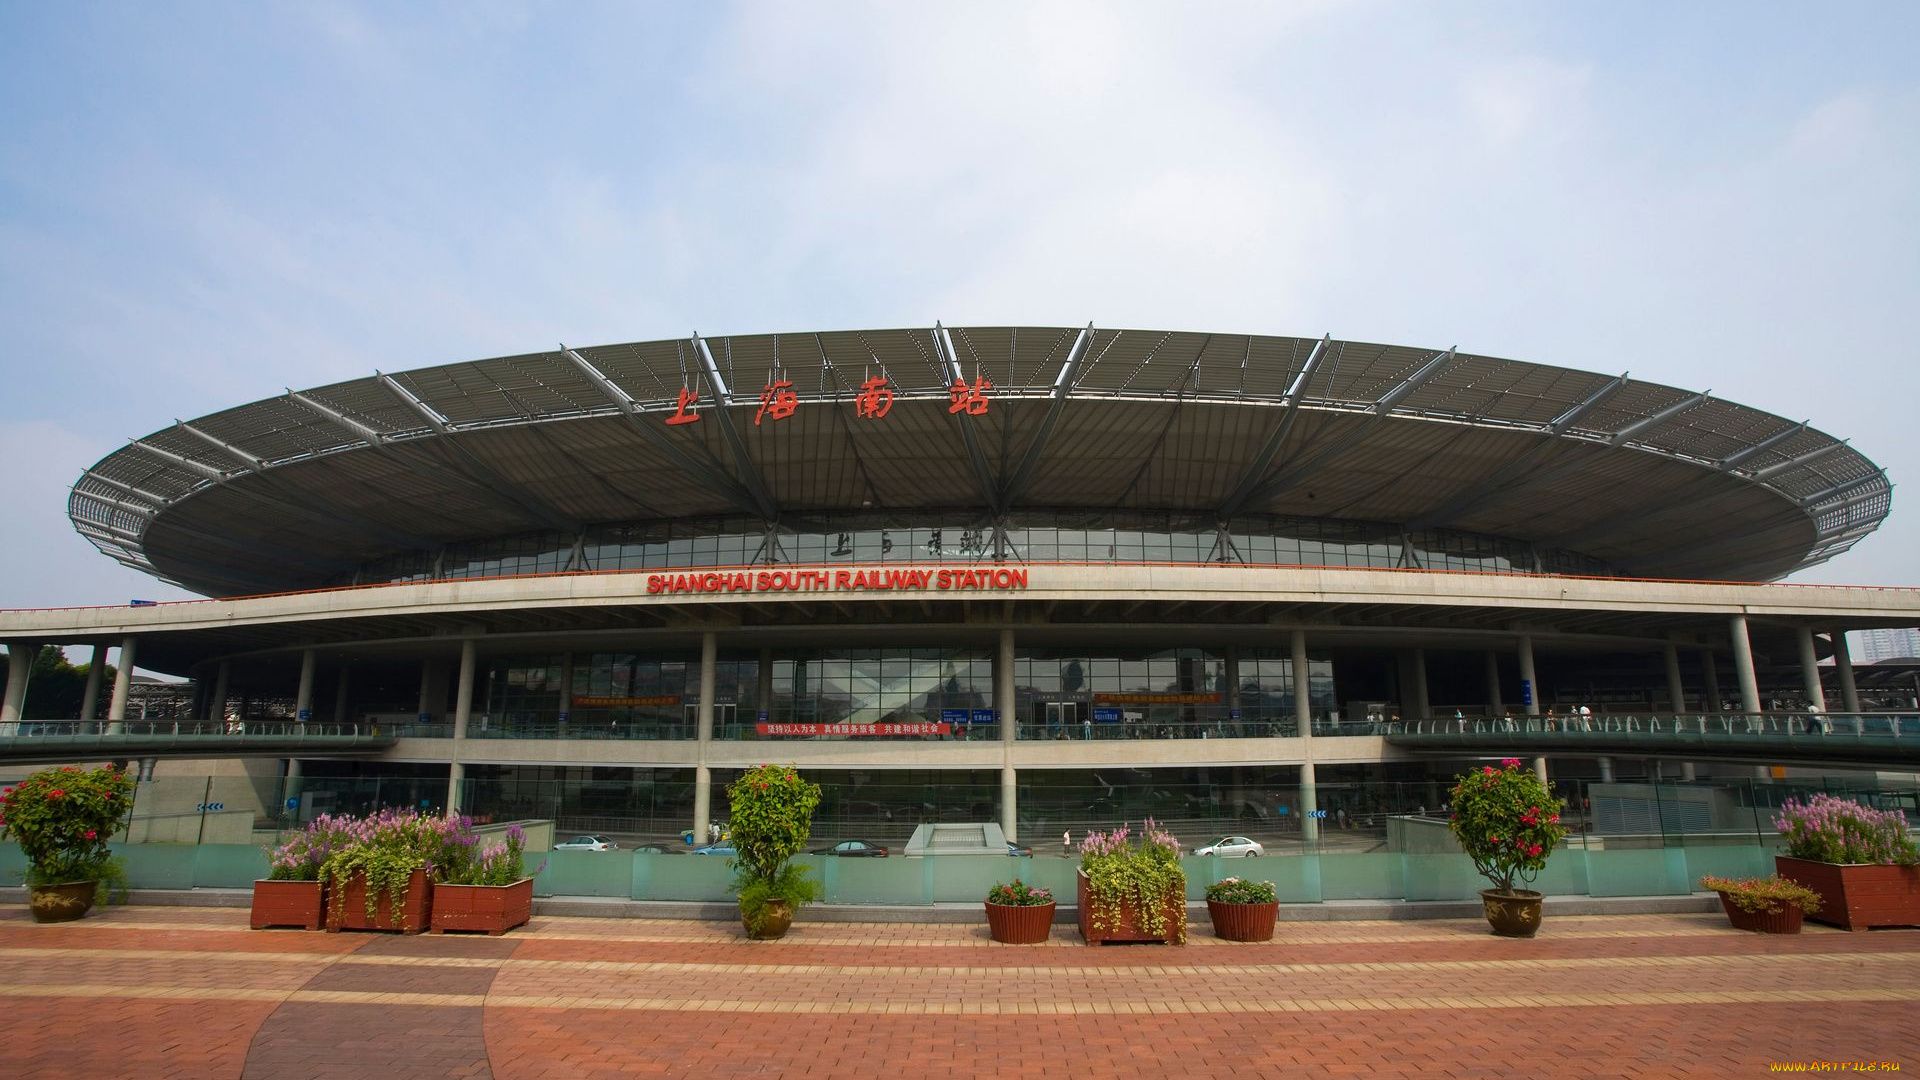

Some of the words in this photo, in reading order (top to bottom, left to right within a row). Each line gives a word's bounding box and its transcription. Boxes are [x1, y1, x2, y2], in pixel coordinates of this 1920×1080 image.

[665, 375, 992, 426] 上海南站
[647, 572, 752, 594] SHANGHAI
[756, 571, 829, 592] SOUTH
[834, 570, 934, 591] RAILWAY
[936, 568, 1029, 590] STATION
[767, 724, 817, 733] 坚持以人为本
[824, 724, 877, 733] 真情服务旅客
[884, 723, 939, 733] 共建和谐社会
